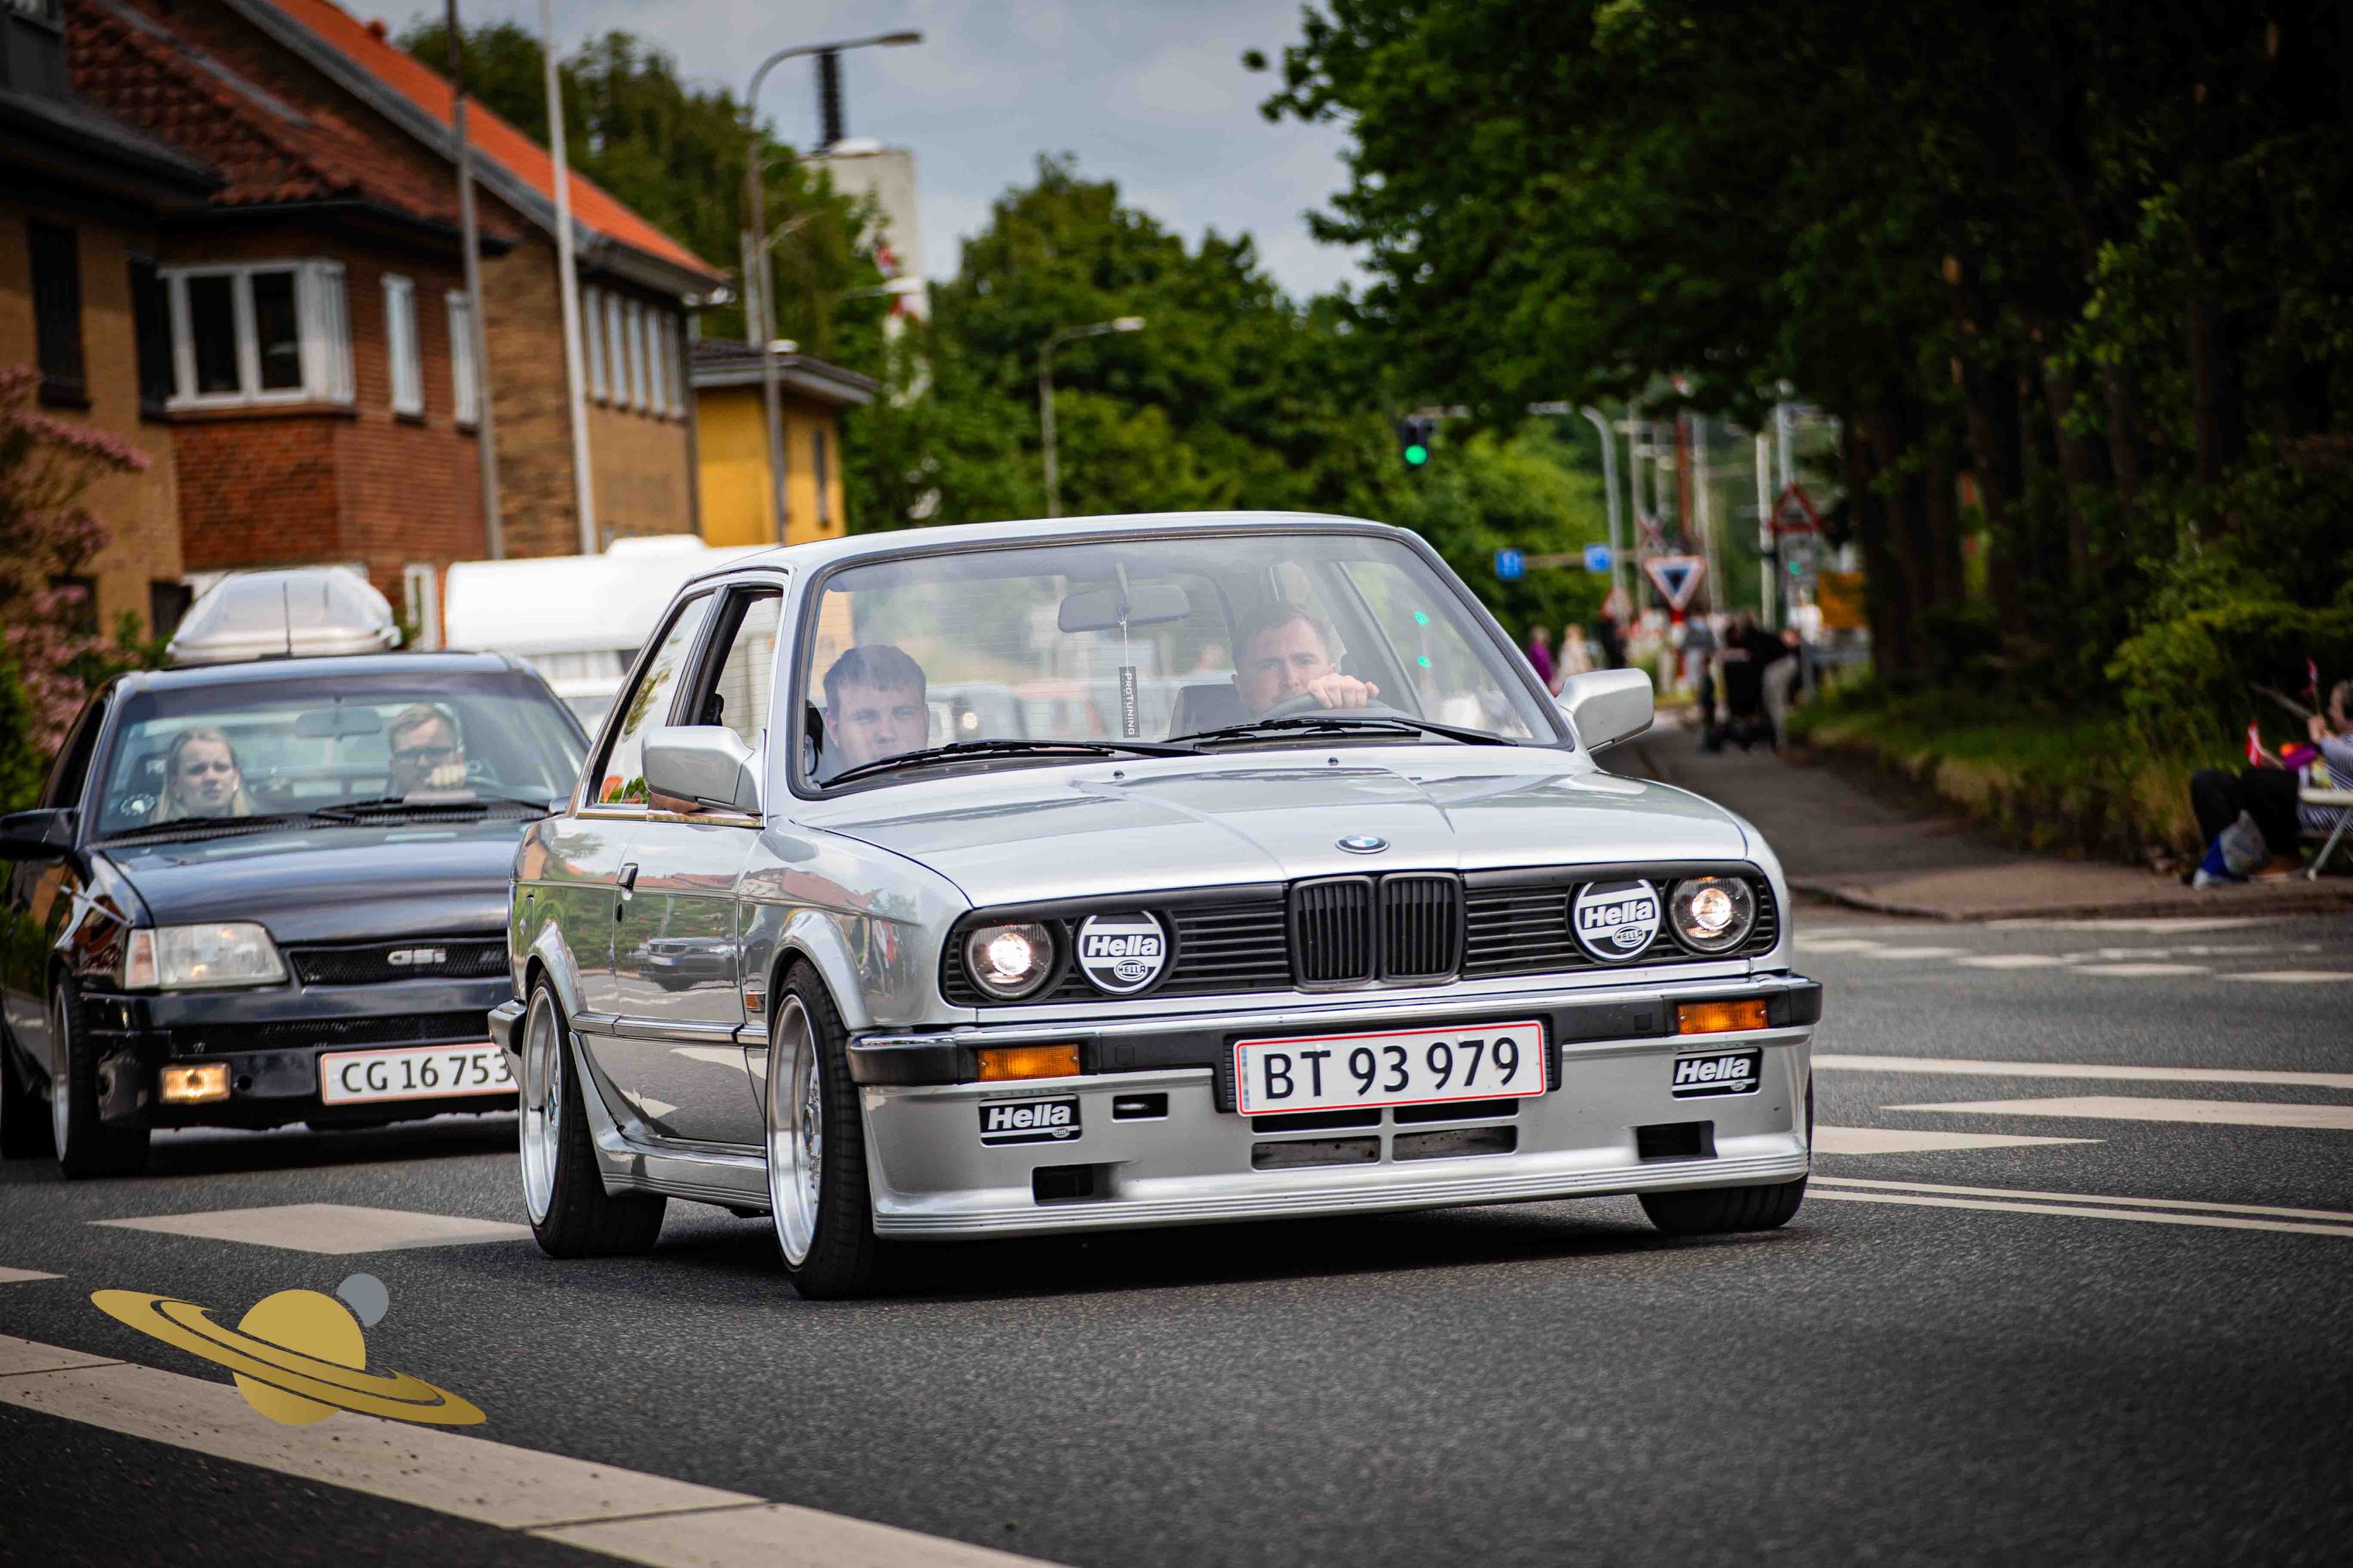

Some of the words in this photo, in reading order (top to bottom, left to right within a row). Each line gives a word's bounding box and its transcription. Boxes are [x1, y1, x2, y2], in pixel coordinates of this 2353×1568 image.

[1125, 673, 1135, 735] PROTUNING
[1583, 901, 1653, 928] Hella
[1088, 935, 1159, 956] Hella
[1118, 965, 1146, 974] HELLA
[341, 1061, 388, 1092] CG
[401, 1057, 439, 1089] 16
[449, 1052, 513, 1086] 753
[1263, 1049, 1331, 1100] BT
[1348, 1045, 1409, 1096] 93
[1427, 1037, 1519, 1090] 979
[1675, 1057, 1750, 1084] Hella
[988, 1103, 1071, 1130] Hella
